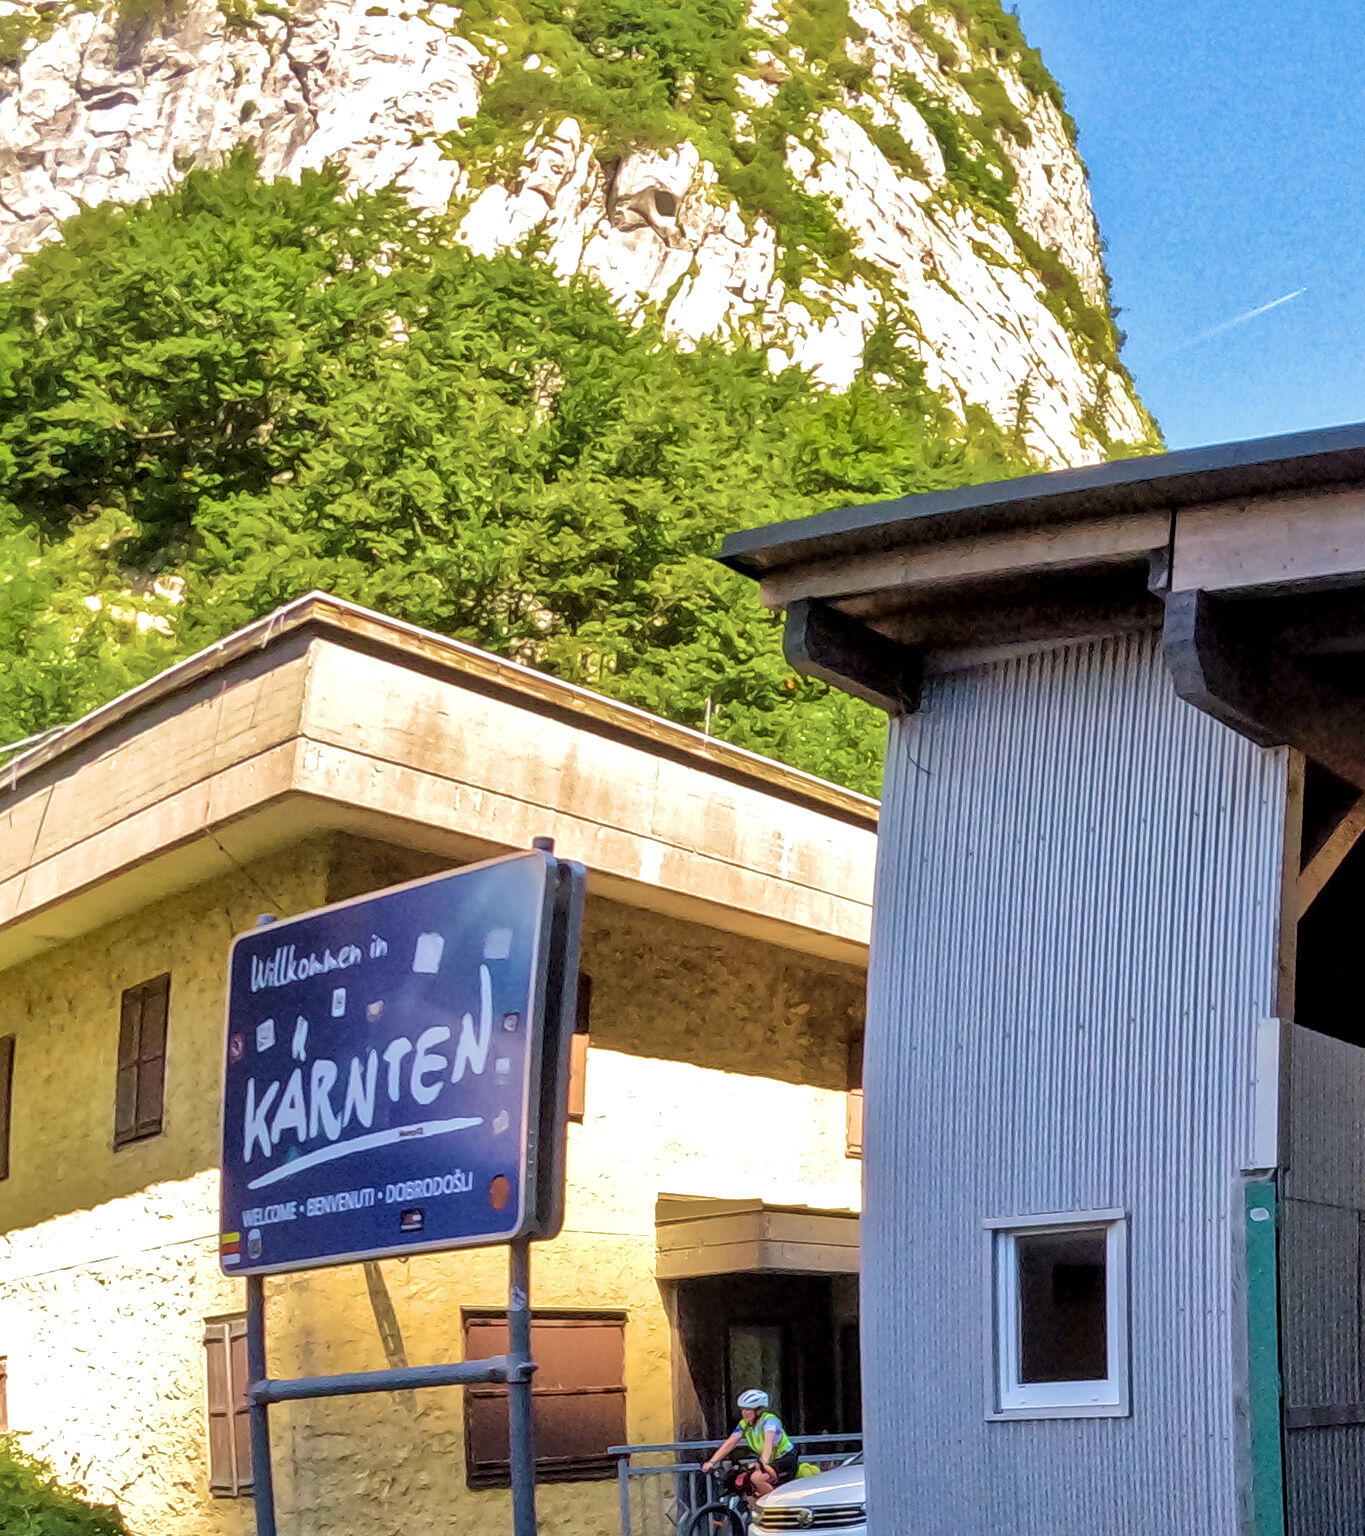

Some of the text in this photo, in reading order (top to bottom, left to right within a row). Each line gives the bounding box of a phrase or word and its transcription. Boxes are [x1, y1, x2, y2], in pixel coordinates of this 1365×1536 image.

[250, 933, 388, 993] Willkommen in
[243, 964, 492, 1163] KÄRNTEN
[242, 1168, 474, 1227] WELCOME BENVENUTI DOBRODOŠLI
